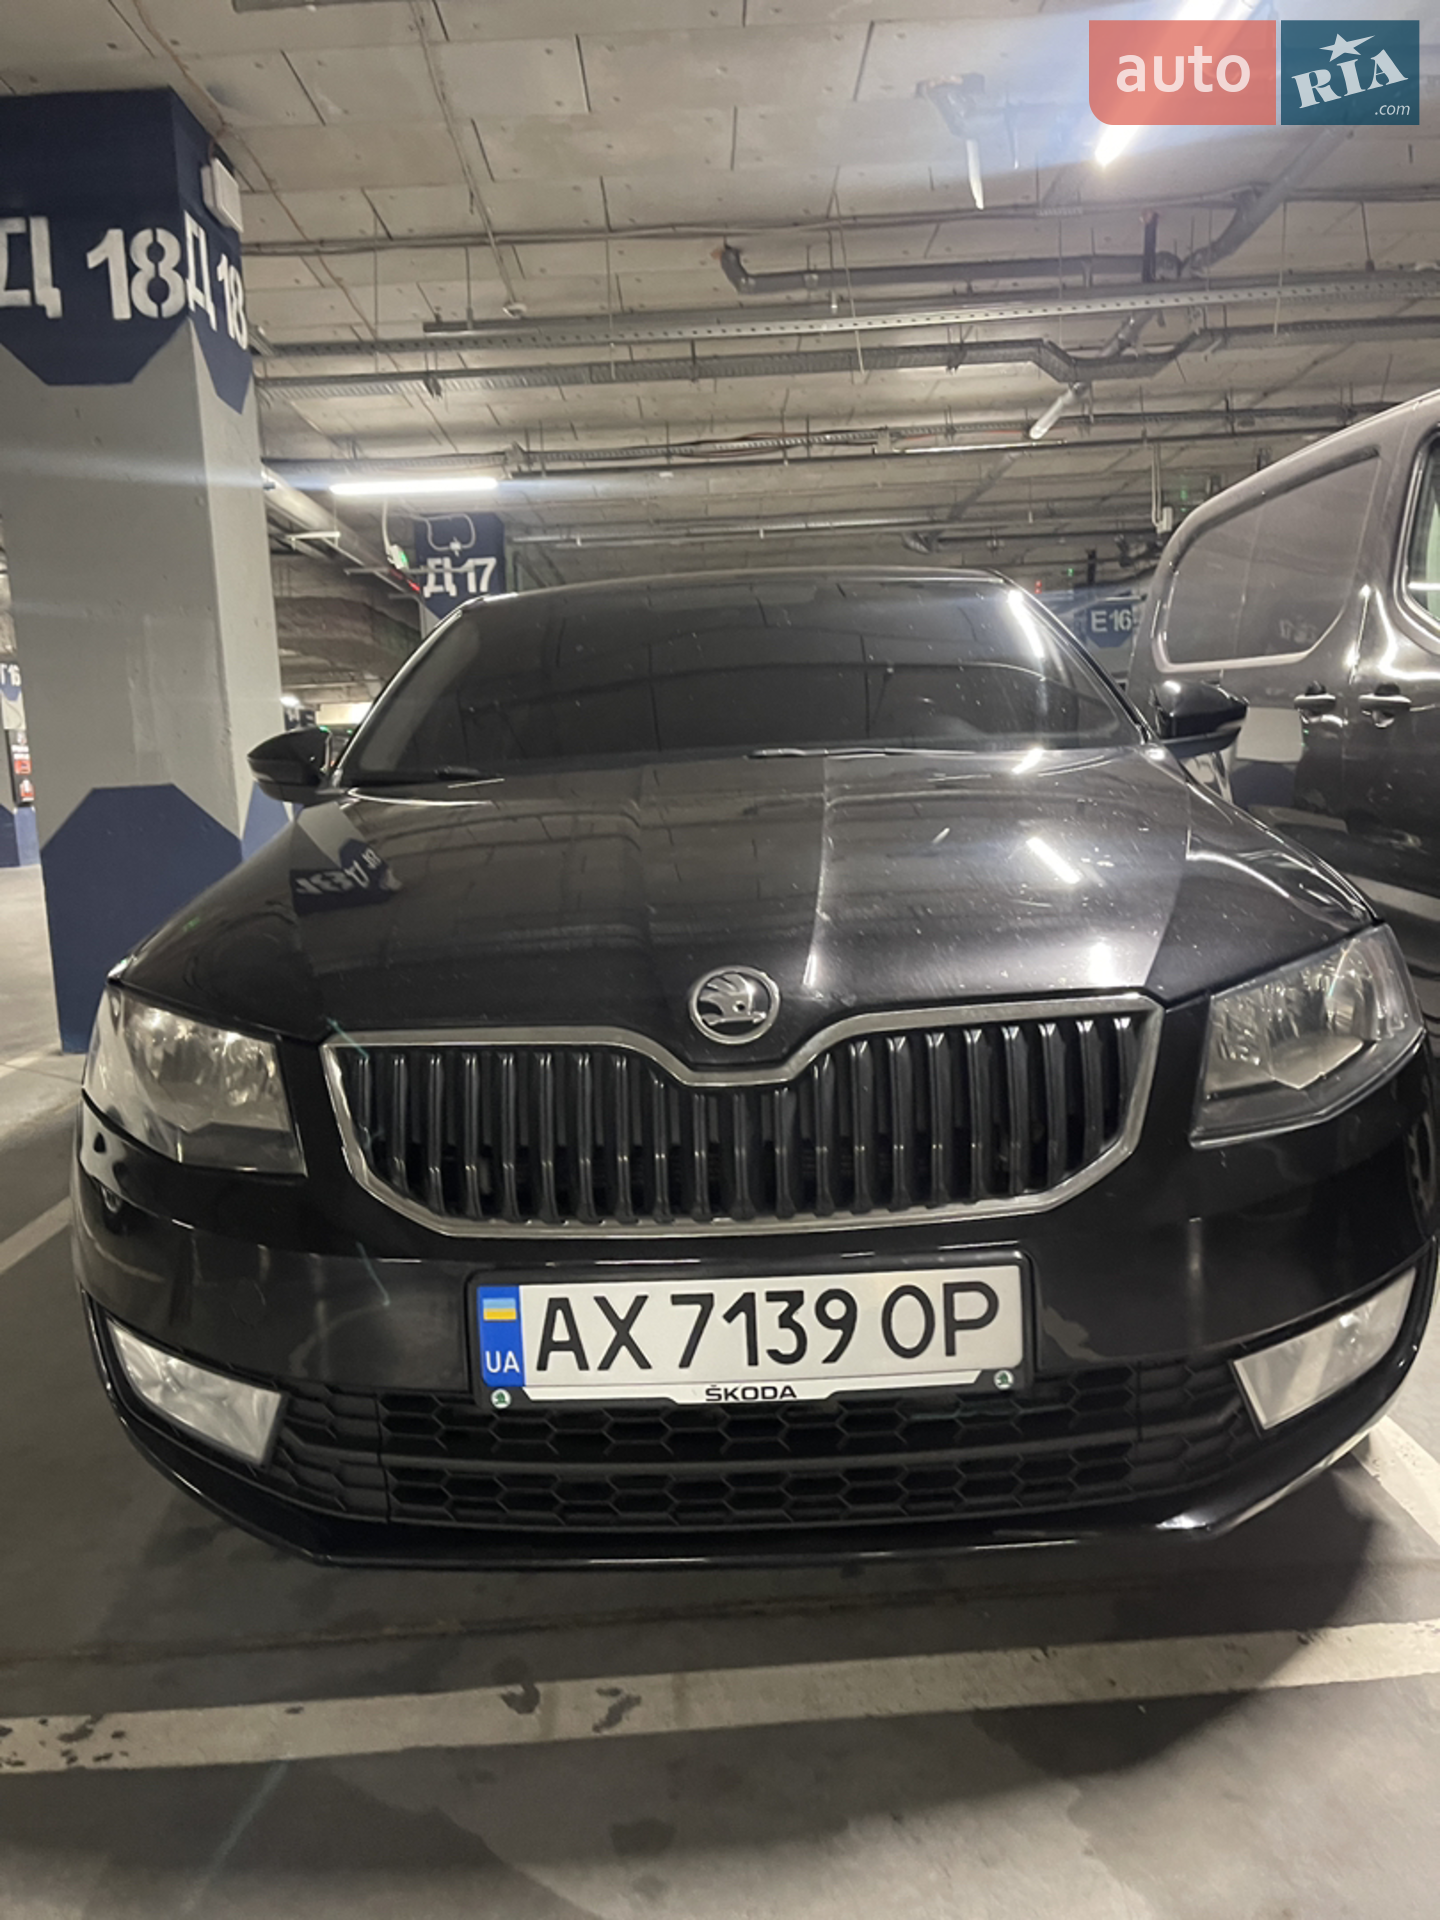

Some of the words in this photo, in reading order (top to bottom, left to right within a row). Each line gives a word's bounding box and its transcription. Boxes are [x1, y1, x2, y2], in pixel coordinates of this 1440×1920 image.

[86, 228, 187, 320] 18
[184, 209, 217, 332] Д
[216, 252, 248, 351] 18
[462, 556, 497, 593] 17
[1109, 609, 1132, 631] 16
[536, 1294, 653, 1371] AX
[670, 1288, 858, 1369] 7139
[881, 1281, 999, 1359] OP
[485, 1351, 520, 1373] UA
[705, 1385, 797, 1402] ŠKODA
